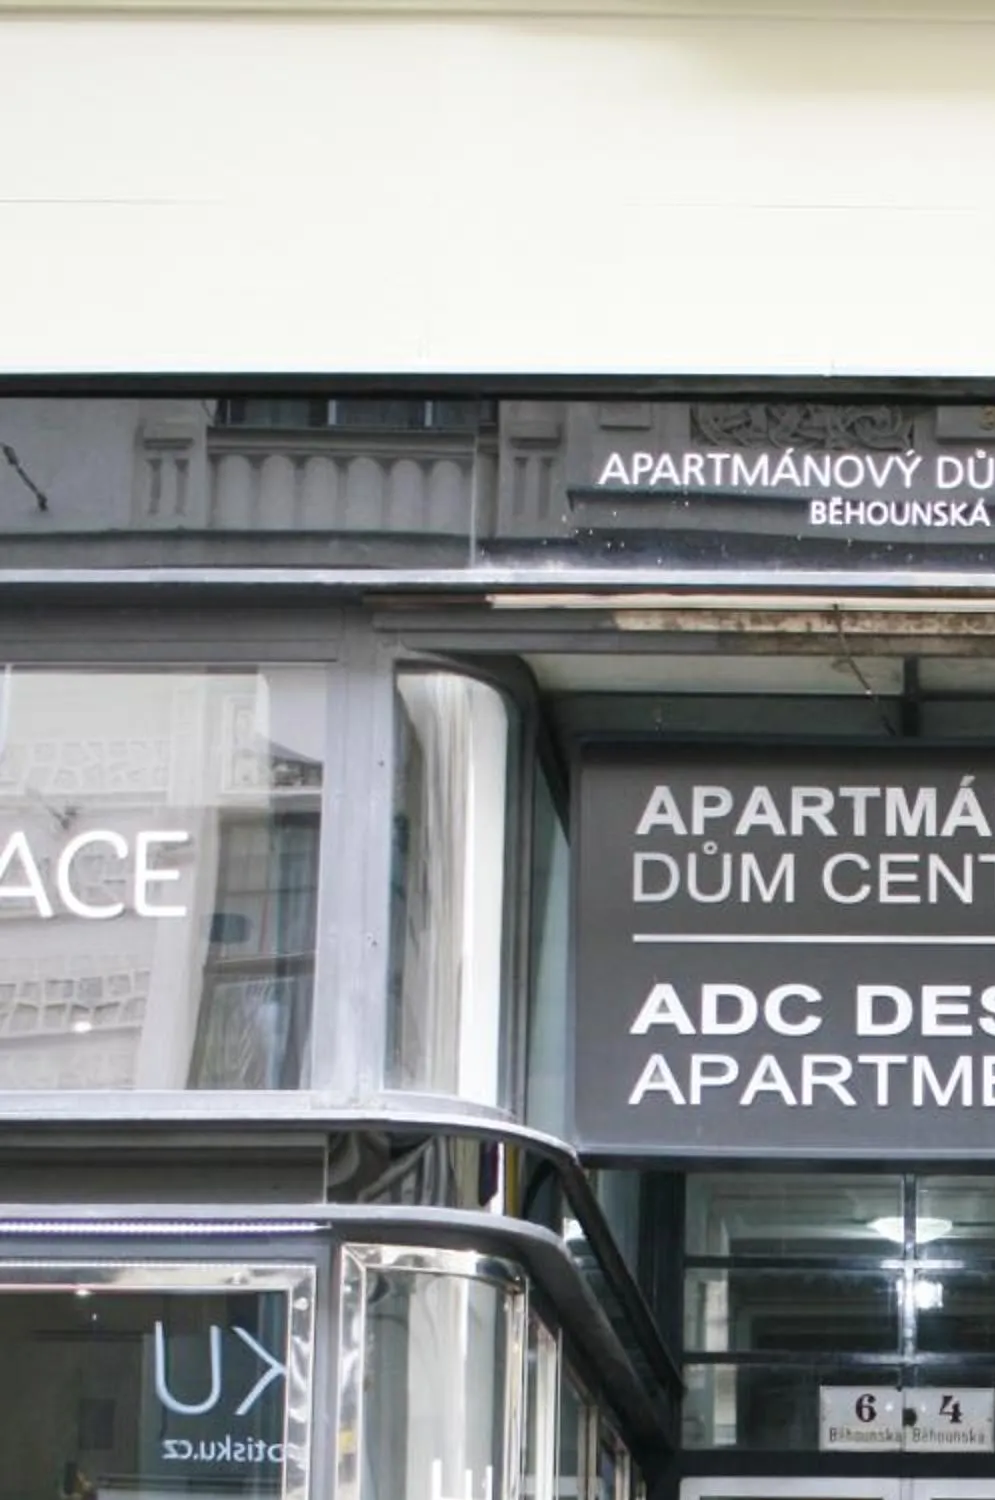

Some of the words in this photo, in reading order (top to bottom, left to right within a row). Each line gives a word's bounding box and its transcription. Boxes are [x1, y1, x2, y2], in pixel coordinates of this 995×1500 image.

[597, 447, 923, 489] APARTMÁNOVÝ
[810, 497, 991, 527] BĚHOUNSKÁ
[0, 830, 189, 918] ACE
[632, 841, 795, 903] DŮM
[629, 983, 823, 1037] ADC
[855, 1393, 877, 1423] 6
[939, 1395, 963, 1424] 4
